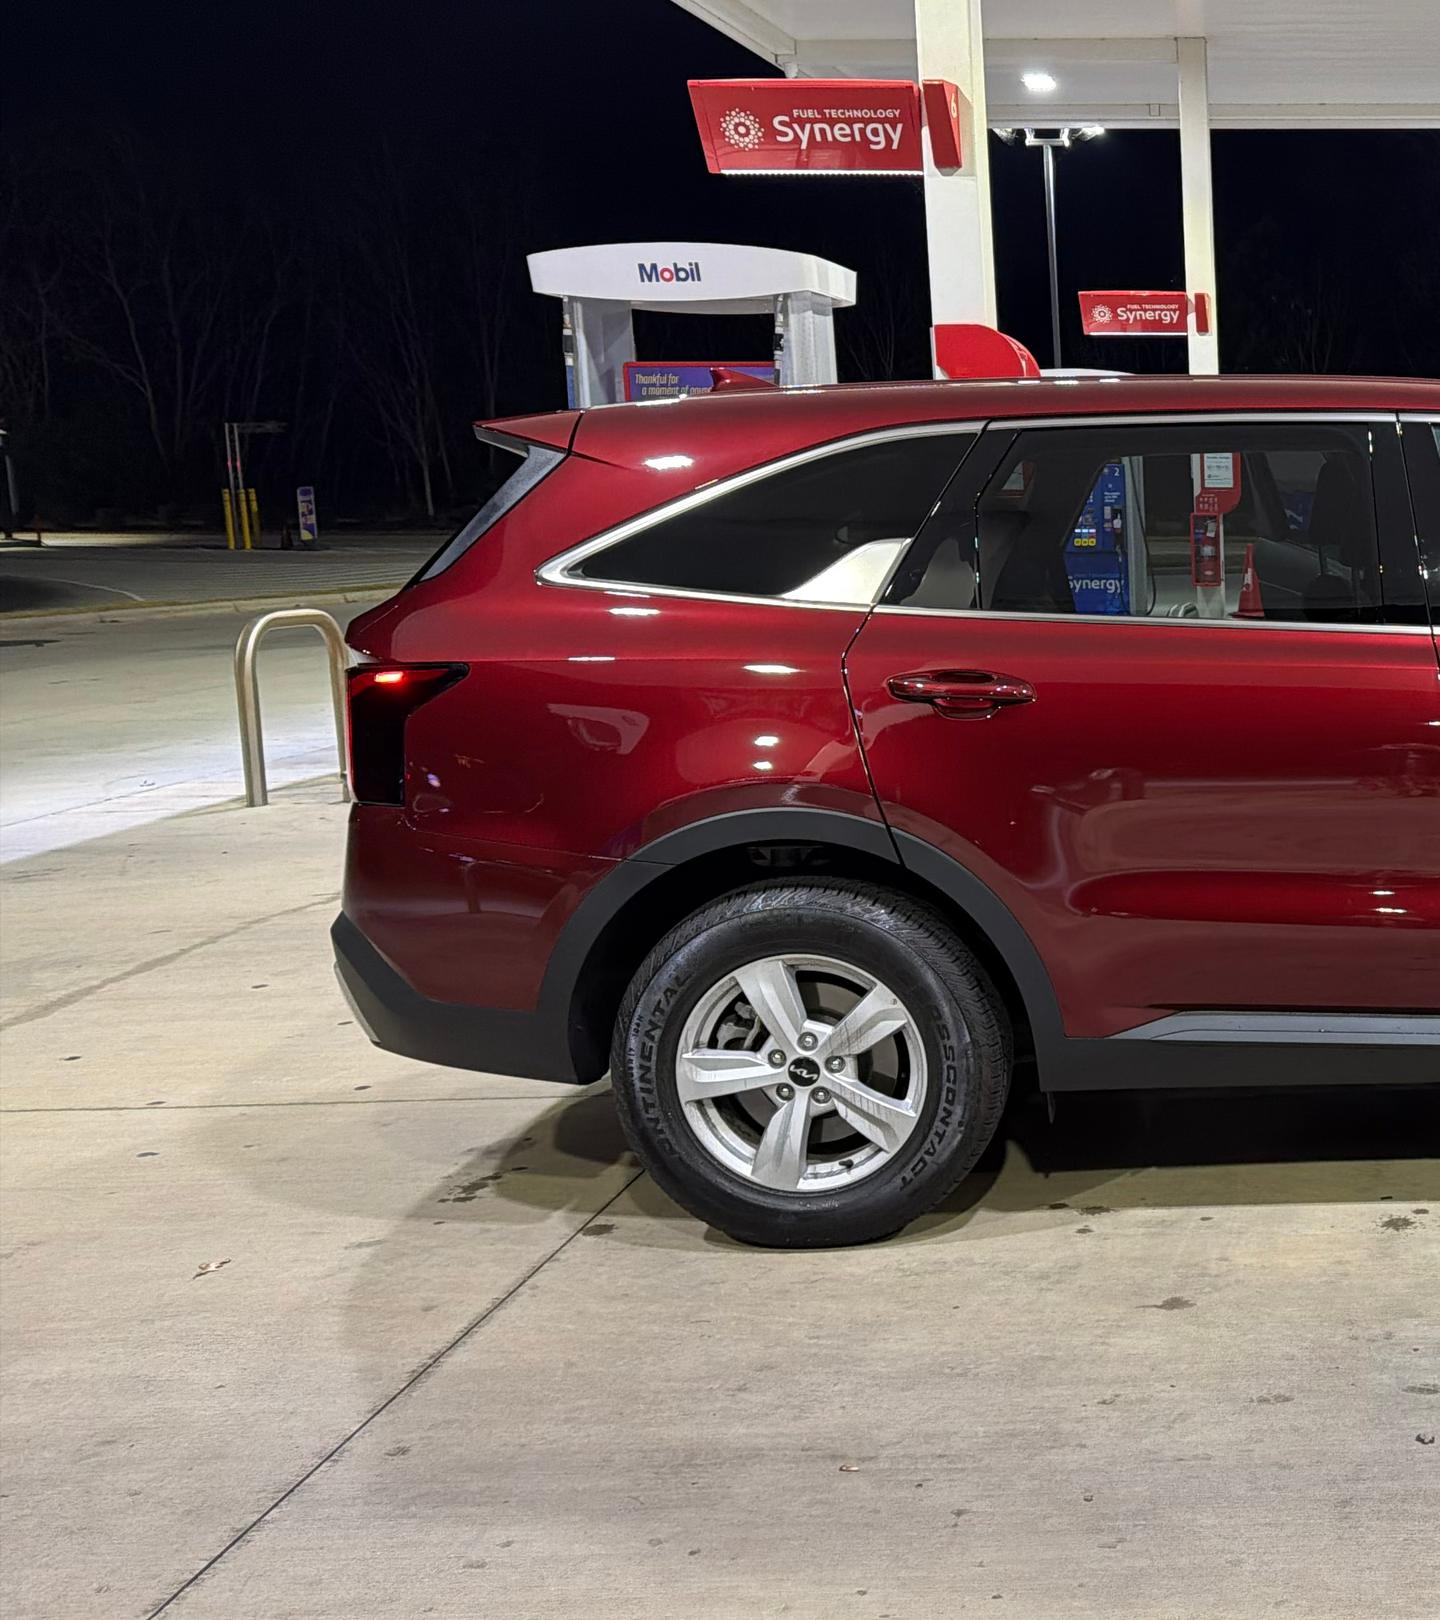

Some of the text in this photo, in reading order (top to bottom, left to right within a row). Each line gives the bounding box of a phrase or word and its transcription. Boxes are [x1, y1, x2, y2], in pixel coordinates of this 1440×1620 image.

[793, 108, 901, 118] FUEL TECHNOLOGY
[772, 115, 904, 150] Synergy
[637, 262, 702, 283] Mobil
[1116, 307, 1180, 324] Synergy
[635, 372, 680, 386] Thankful for
[648, 386, 679, 395] moment
[1114, 467, 1120, 477] 2
